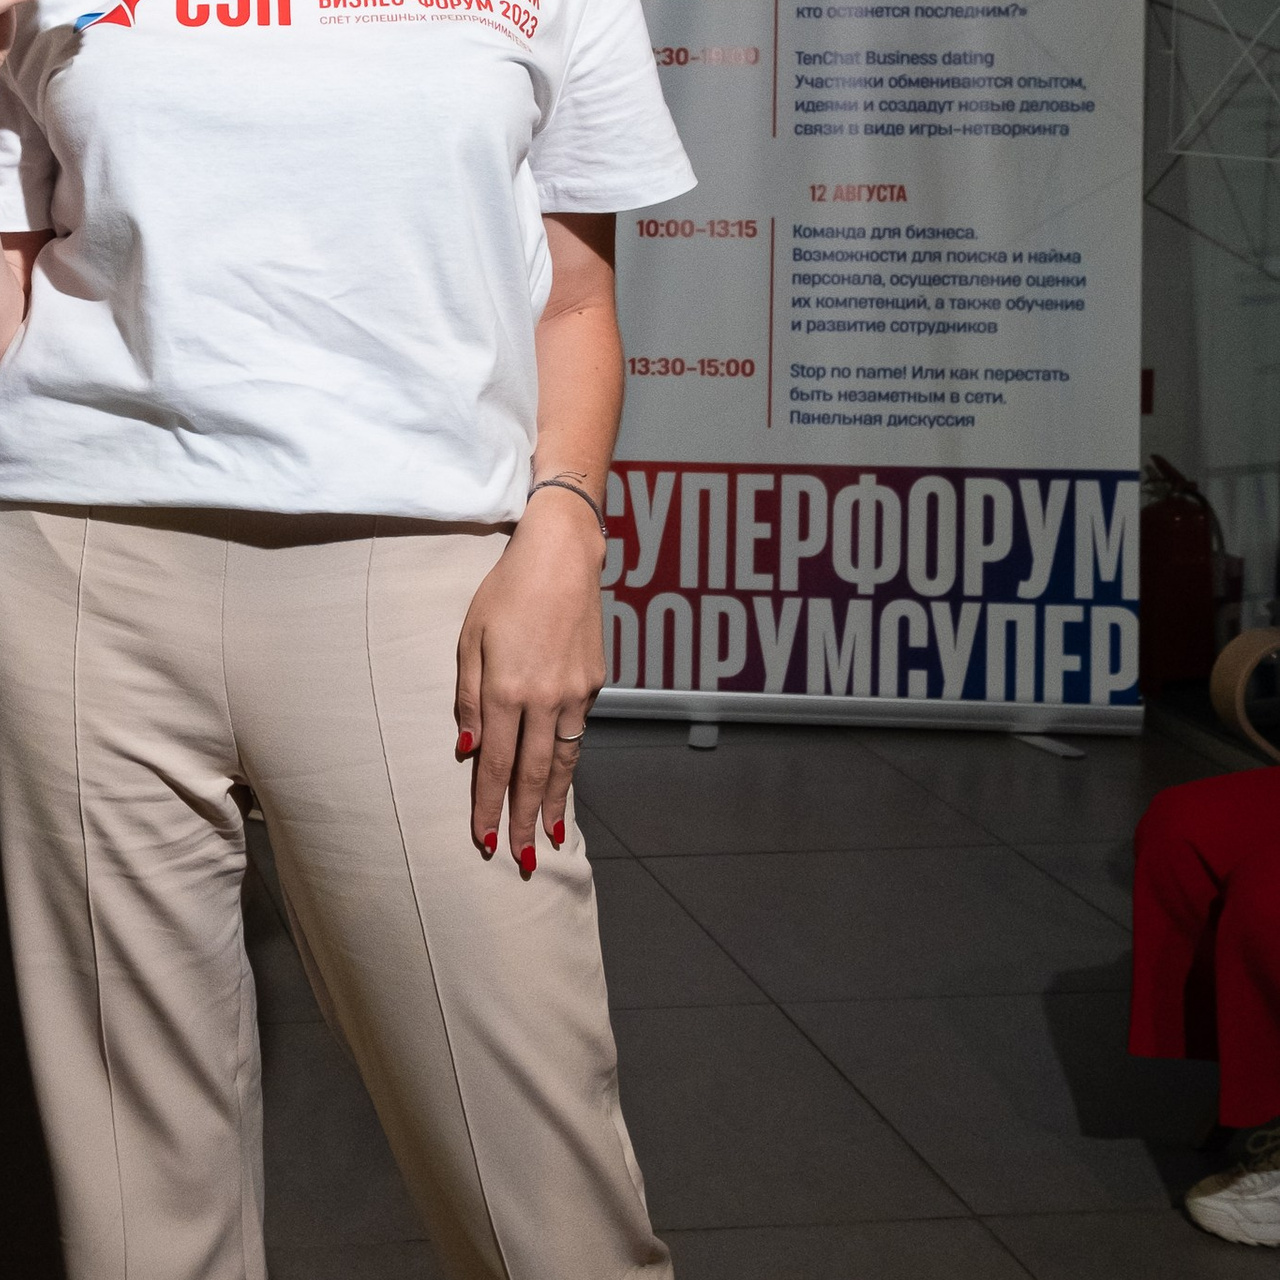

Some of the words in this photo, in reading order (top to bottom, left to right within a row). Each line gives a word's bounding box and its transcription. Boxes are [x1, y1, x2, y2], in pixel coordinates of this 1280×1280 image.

[354, 13, 427, 24] УСПЕШНЫХ
[500, 0, 539, 39] 2023
[796, 5, 823, 19] кто
[865, 50, 938, 66] Business
[941, 50, 995, 68] dating
[888, 73, 1013, 89] обмениваются
[1017, 76, 1087, 91] опытом,
[863, 100, 874, 112] и
[878, 99, 953, 115] создадут
[958, 99, 1016, 113] новые
[1018, 99, 1096, 114] деловые
[794, 123, 844, 137] связи
[863, 124, 905, 137] виде
[909, 123, 1070, 139] игры-нетворкинга
[810, 184, 827, 202] 12
[832, 184, 907, 202] АВГУСТА
[792, 224, 866, 240] Команда
[870, 226, 901, 240] для
[905, 224, 978, 240] бизнеса.
[792, 247, 907, 262] Возможности
[911, 250, 942, 264] для
[946, 250, 1007, 264] поиска
[1012, 251, 1023, 264] и
[1027, 248, 1082, 264] найма
[791, 273, 886, 288] персонала,
[889, 274, 1022, 289] осуществление
[1026, 274, 1087, 288] оценки
[791, 296, 811, 309] их
[815, 295, 931, 310] компетенций,
[935, 298, 945, 310] а
[949, 297, 1002, 310] также
[1006, 295, 1086, 313] обучение
[791, 320, 802, 332] и
[806, 320, 886, 335] развитие
[890, 321, 998, 336] сотрудников
[789, 363, 826, 381] Stop
[830, 366, 852, 380] no
[855, 365, 907, 380] name!
[911, 365, 945, 380] Или
[949, 367, 980, 381] как
[983, 368, 1070, 384] перестать
[789, 386, 832, 403] быть
[837, 389, 946, 404] незаметным
[950, 390, 960, 404] в
[964, 391, 1008, 405] сети.
[789, 410, 883, 427] Панельная
[886, 413, 976, 429] дискуссия
[601, 470, 1139, 601] СУПЕРФОРУМ
